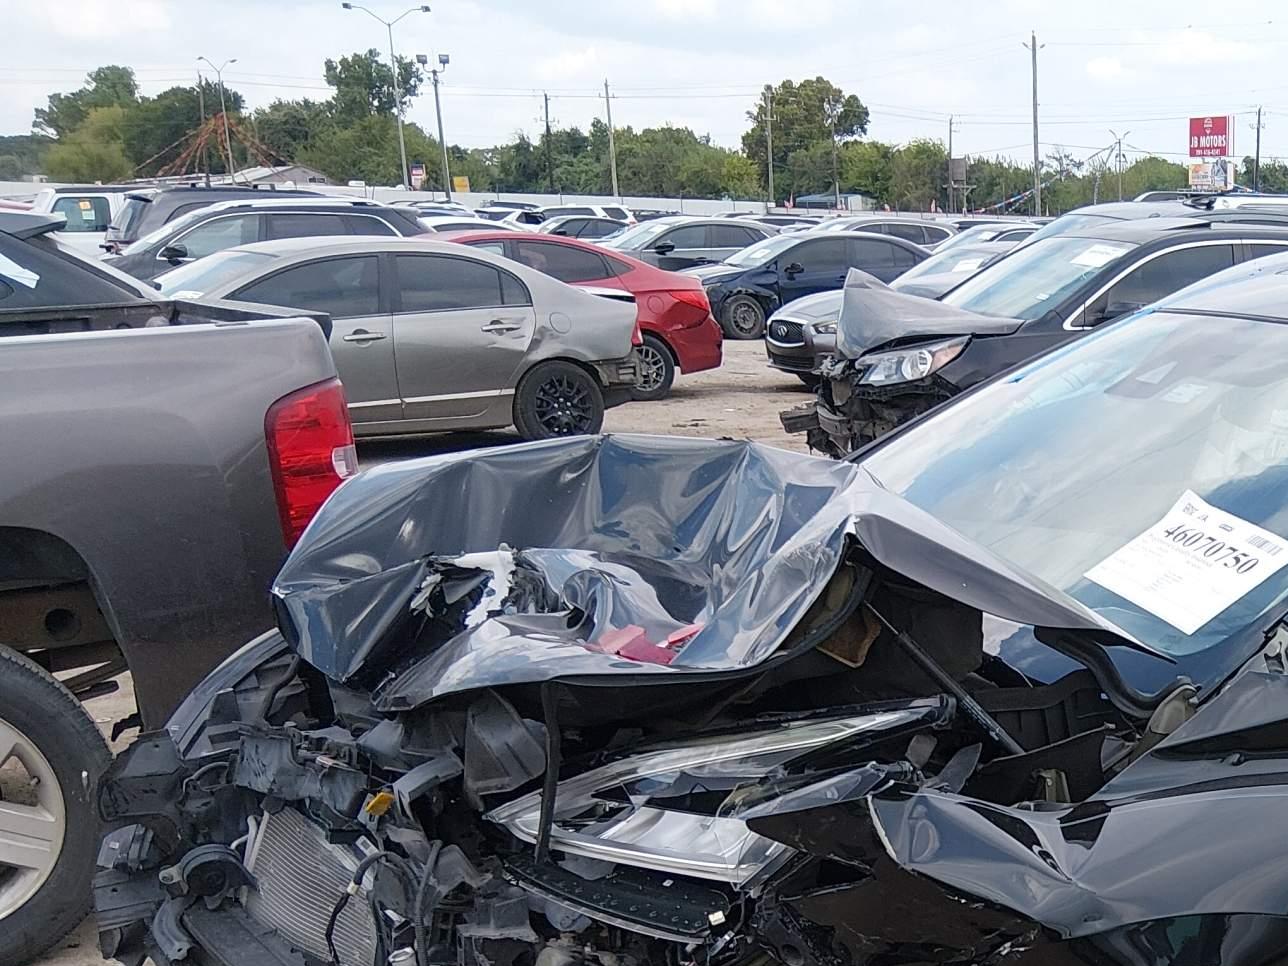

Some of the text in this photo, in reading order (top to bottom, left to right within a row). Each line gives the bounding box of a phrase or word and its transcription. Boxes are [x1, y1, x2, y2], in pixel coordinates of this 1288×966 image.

[1190, 134, 1226, 149] JB MOTORS
[1163, 523, 1259, 574] 46070750
